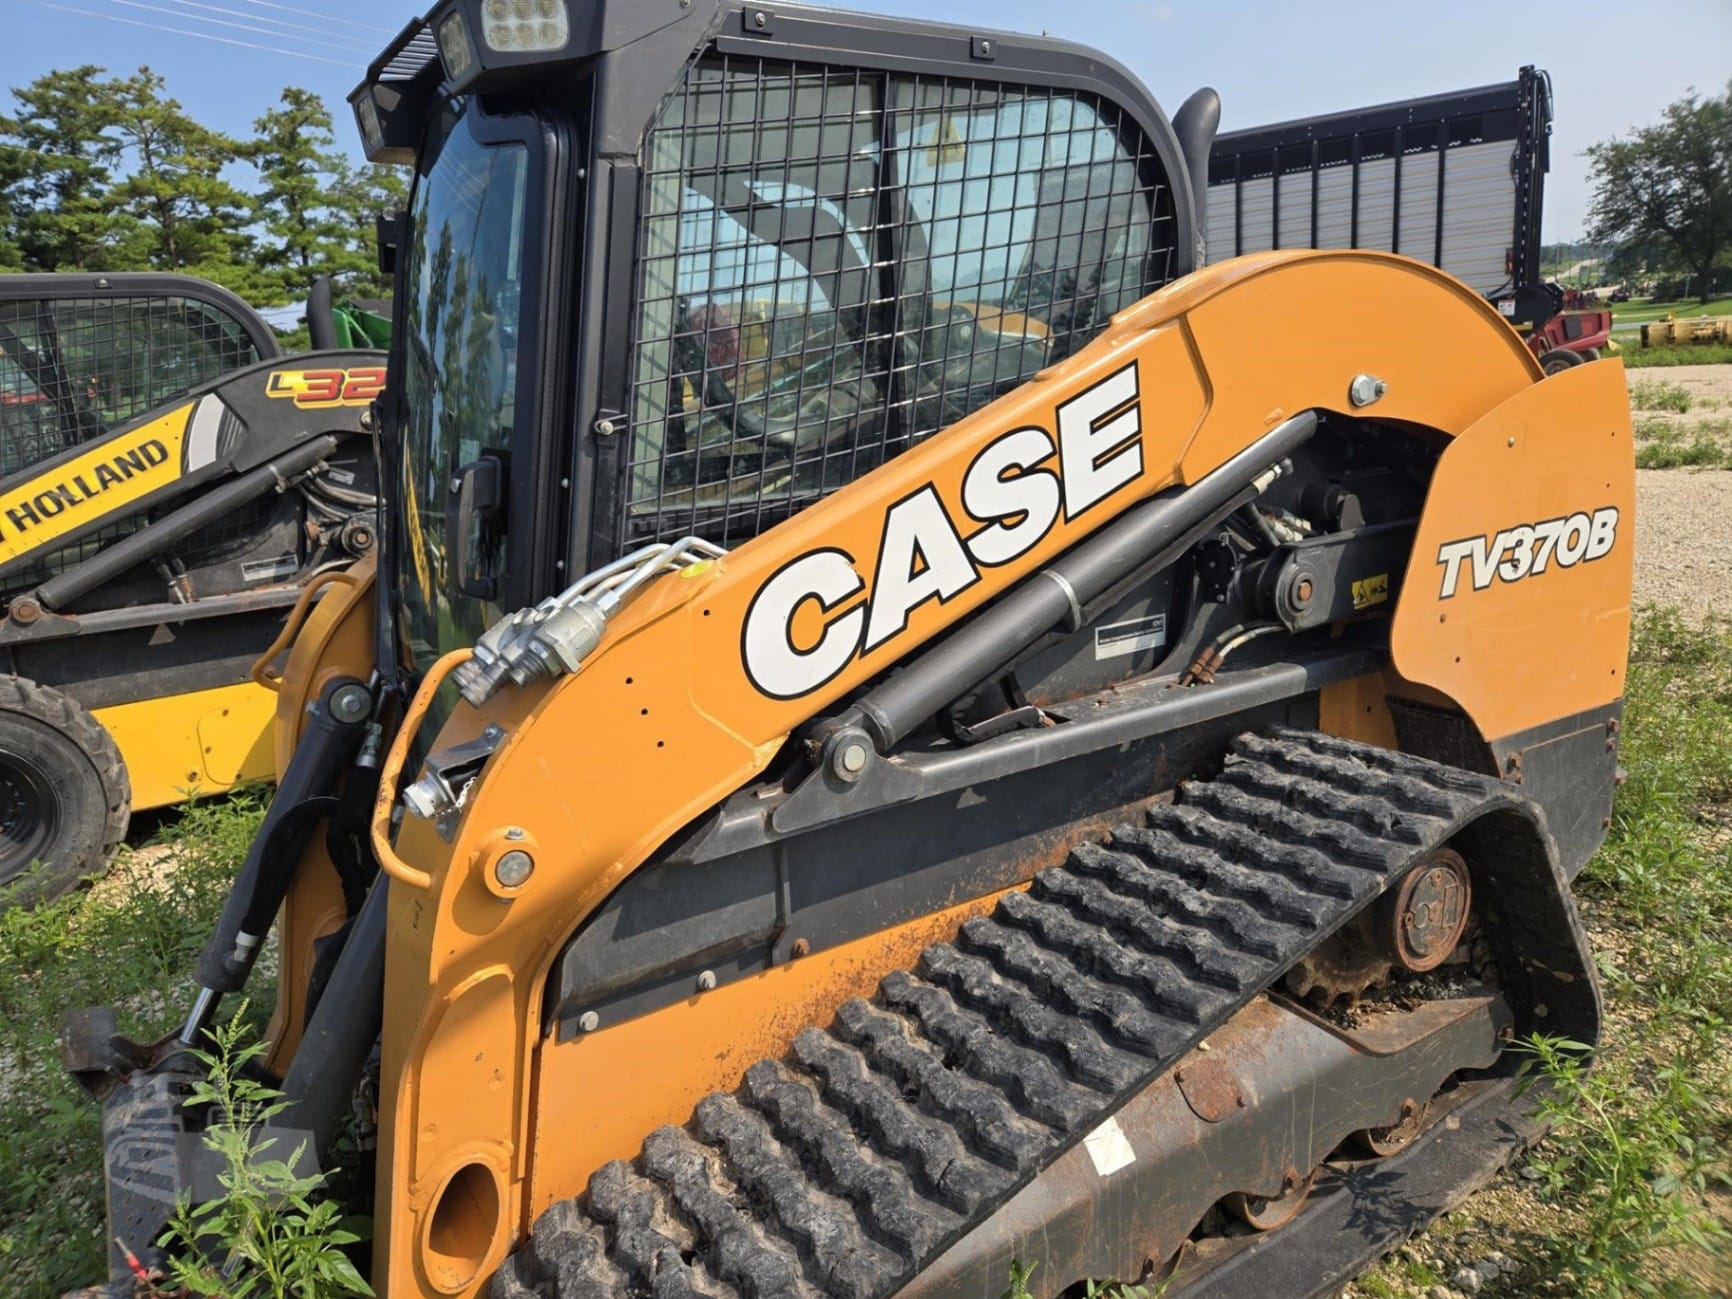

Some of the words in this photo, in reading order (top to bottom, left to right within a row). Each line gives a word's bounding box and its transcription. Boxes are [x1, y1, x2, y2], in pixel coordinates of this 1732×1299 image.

[5, 439, 169, 533] HOLLAND
[741, 358, 1145, 701] CASE
[1437, 506, 1620, 600] TV370B
